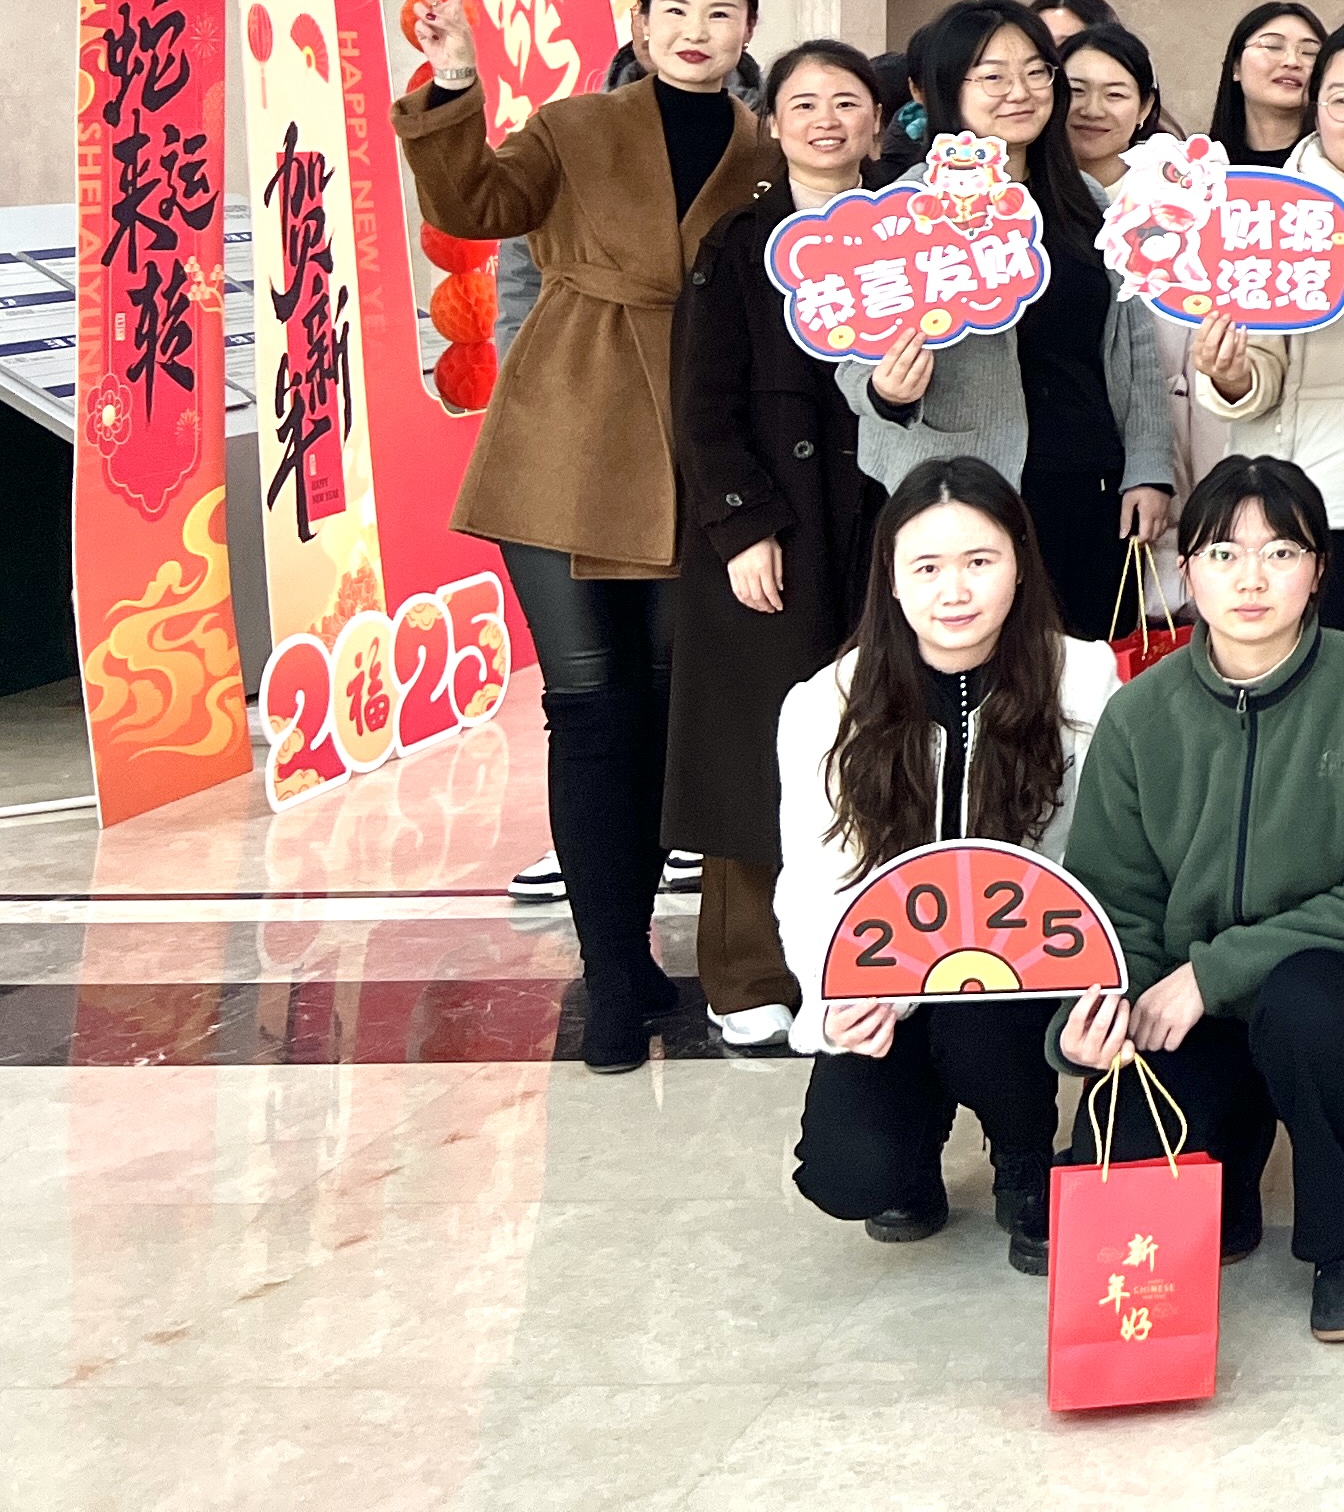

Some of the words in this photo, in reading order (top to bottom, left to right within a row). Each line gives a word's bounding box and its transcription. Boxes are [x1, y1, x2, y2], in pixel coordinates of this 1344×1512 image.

[339, 30, 370, 165] HAPPY
[352, 179, 380, 273] NEW
[1220, 196, 1335, 254] 财源
[794, 228, 1036, 333] 恭喜发财
[1216, 256, 1332, 312] 滚滚
[853, 882, 1085, 968] 2025
[1099, 1233, 1159, 1343] 新年好
